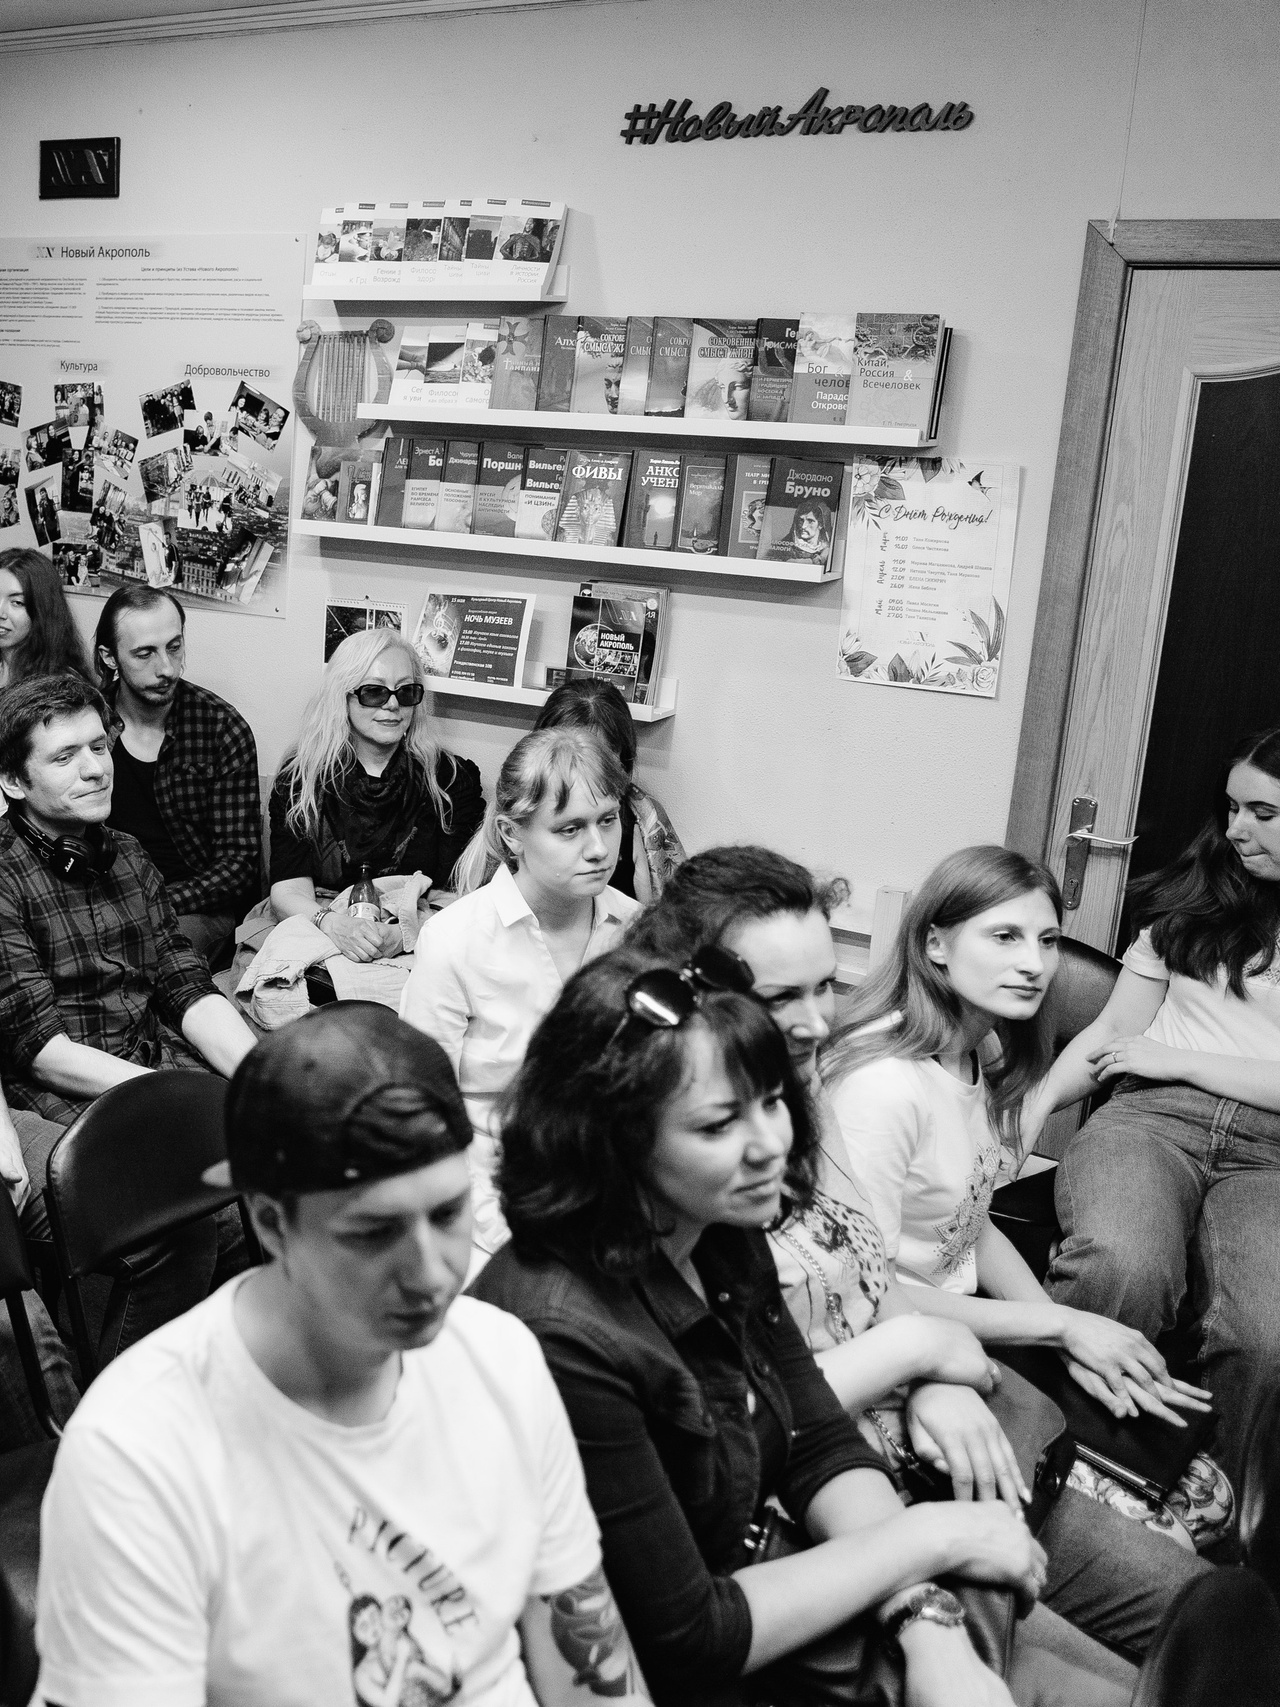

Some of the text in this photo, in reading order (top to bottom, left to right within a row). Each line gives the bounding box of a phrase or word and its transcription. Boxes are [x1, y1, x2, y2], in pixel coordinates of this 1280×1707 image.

[61, 246, 150, 260] Новый Акрополь
[60, 360, 98, 372] Культура
[807, 363, 828, 374] Бог
[857, 358, 889, 368] Китай,
[184, 364, 271, 377] Добровольчество
[859, 368, 895, 378] Россия
[862, 380, 921, 391] Всечеловек
[483, 459, 523, 472] Поршн
[572, 465, 623, 481] ФИВЫ
[787, 469, 834, 483] Джордано
[526, 478, 562, 490] Вильге
[785, 482, 831, 498] Бруно
[879, 504, 892, 519] С
[931, 506, 993, 530] Рождения!
[464, 614, 513, 625] НОЧЬ МУЗЕЕВ
[600, 632, 625, 642] НОВЫЙ
[600, 640, 634, 651] АКРОПОЛЬ
